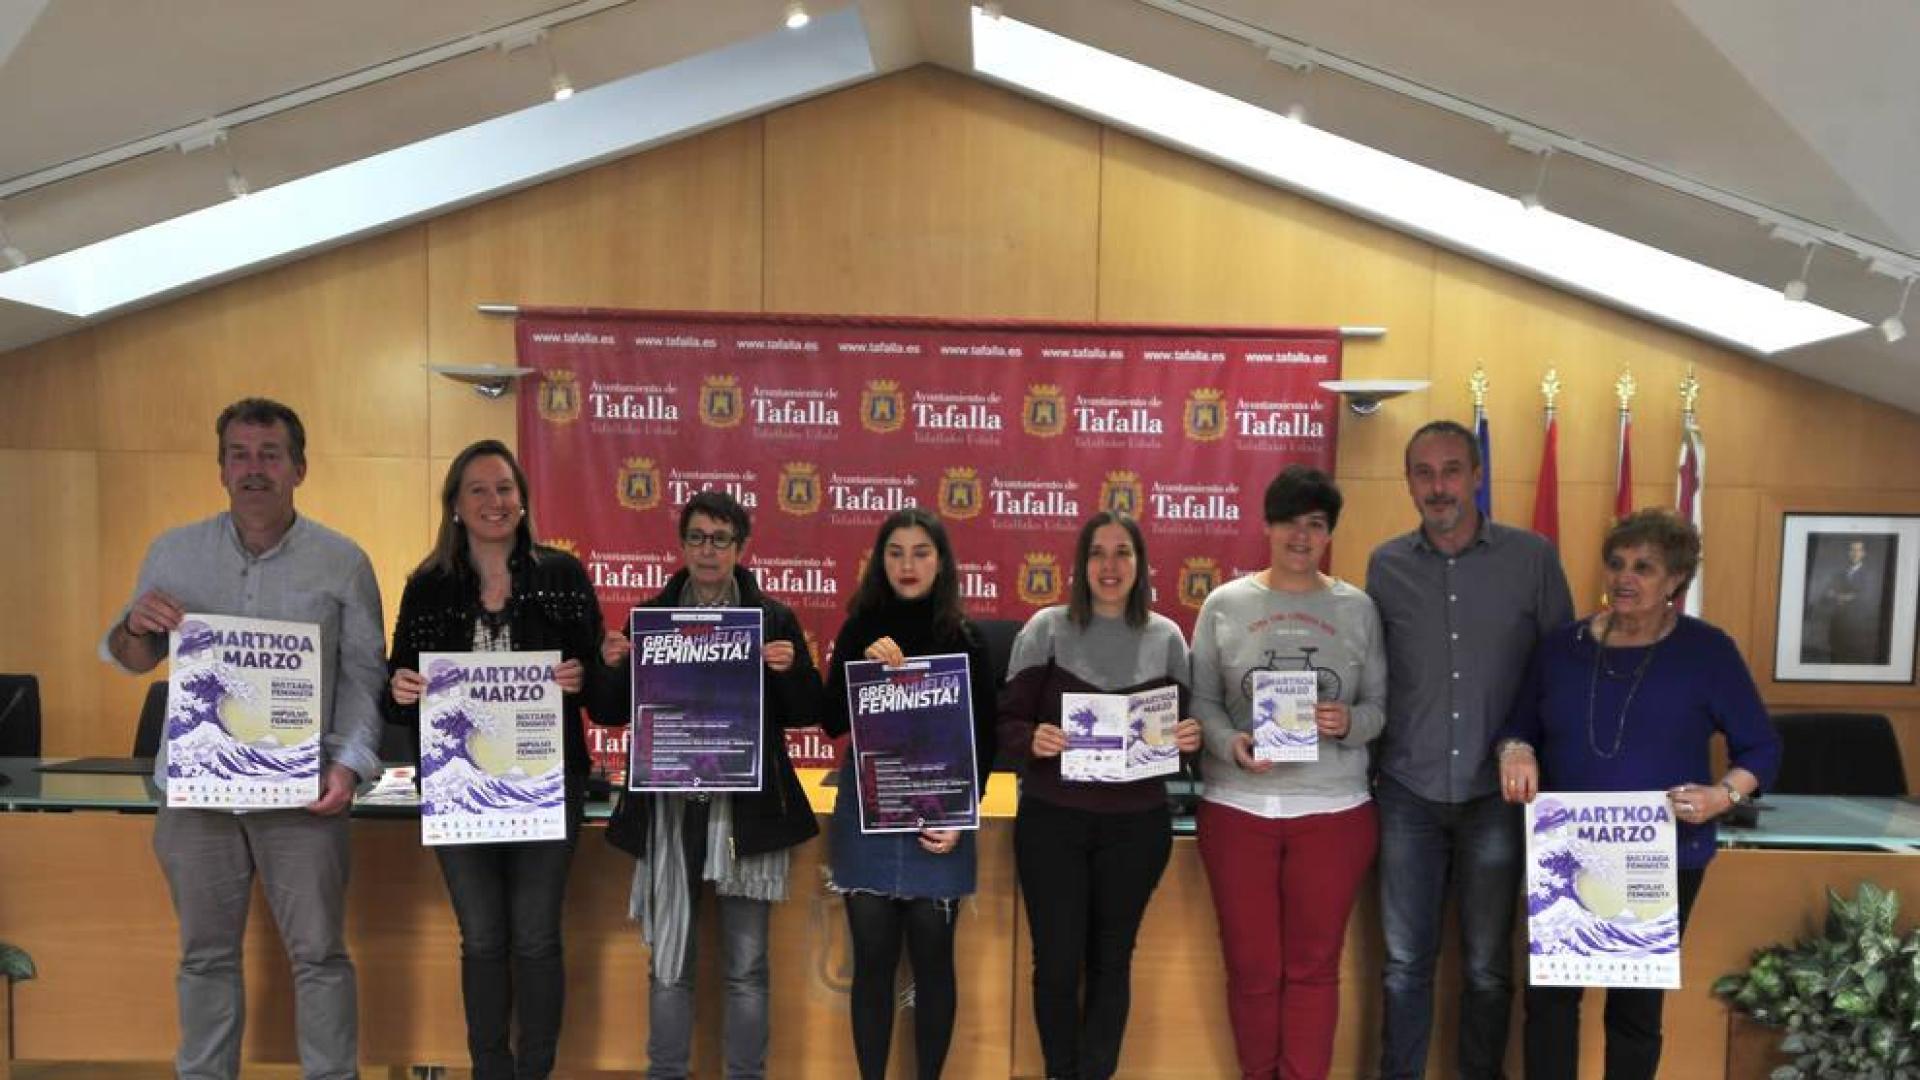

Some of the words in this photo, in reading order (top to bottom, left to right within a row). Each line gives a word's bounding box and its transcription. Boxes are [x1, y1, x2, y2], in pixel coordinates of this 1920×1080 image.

[532, 331, 616, 345] www.tafalla.es
[635, 335, 717, 348] www.tafalla.es
[737, 337, 819, 351] www.tafalla.es
[838, 340, 921, 354] www.tafalla.es
[940, 342, 1023, 357] www.tafalla.es
[1041, 346, 1124, 360] www.tafalla.es
[1143, 349, 1226, 362] www.tafalla.es
[1245, 352, 1328, 364] www.tafalla.es
[590, 381, 662, 394] Ayuntamiento
[663, 383, 677, 393] de
[752, 385, 823, 398] Ayuntamiento
[825, 387, 838, 399] de
[913, 391, 985, 404] Ayuntamiento
[987, 392, 1000, 404] de
[1074, 395, 1146, 407] Ayuntamiento
[1148, 395, 1162, 408] de
[1236, 398, 1309, 411] Ayuntamiento
[1311, 399, 1324, 412] de
[589, 393, 678, 420] Tafalla
[751, 399, 840, 425] Tafalla
[912, 403, 1001, 430] Tafalla
[1073, 408, 1163, 433] Tafalla
[1234, 411, 1324, 437] Tafalla
[669, 468, 740, 480] Ayuntamiento
[742, 470, 757, 481] de
[829, 472, 902, 485] Ayuntamiento
[903, 474, 918, 486] de
[990, 476, 1063, 489] Ayuntamiento
[1064, 478, 1079, 490] de
[1152, 481, 1224, 493] Ayuntamiento
[1225, 483, 1239, 494] de
[668, 480, 758, 507] Tlla
[828, 486, 918, 511] Tafalla
[989, 490, 1079, 516] Tafalla
[1150, 493, 1240, 520] Tafalla
[589, 550, 661, 562] Ayuntamiento
[662, 551, 677, 563] de
[749, 554, 821, 567] Ayuntamiento
[822, 557, 837, 567] de
[748, 567, 838, 594] Tafalla
[207, 630, 314, 653] MARTXOA
[223, 650, 302, 670] MARZO
[641, 641, 752, 666] FEMINISTA!
[453, 664, 556, 683] MARTXOA
[470, 684, 544, 702] MARZO
[858, 686, 960, 715] FEMINISTA!
[1560, 805, 1670, 823] MARTXOA
[1578, 825, 1656, 843] MARZO
